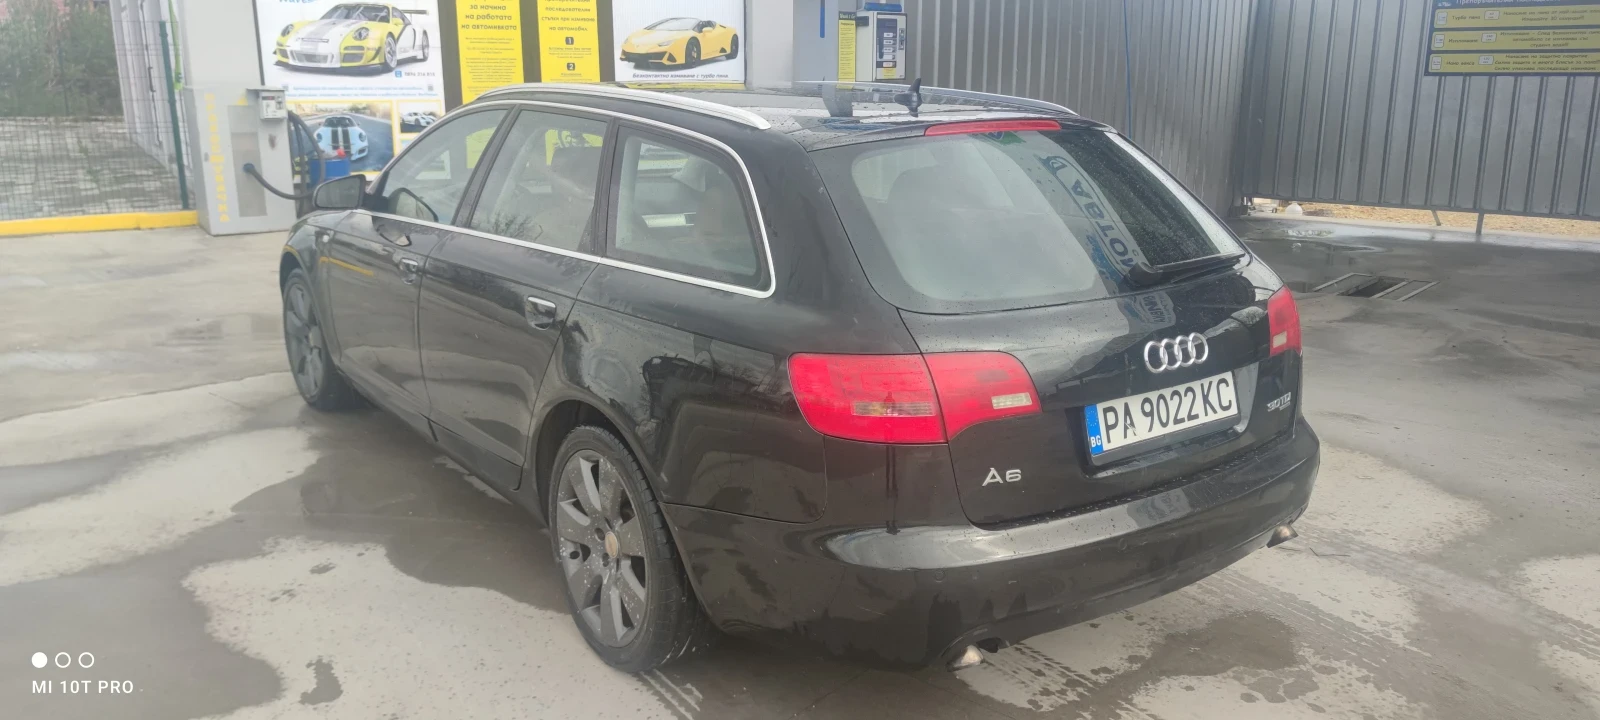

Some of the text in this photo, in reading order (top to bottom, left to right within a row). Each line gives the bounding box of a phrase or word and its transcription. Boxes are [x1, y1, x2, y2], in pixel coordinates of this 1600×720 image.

[476, 13, 512, 21] работата
[1102, 377, 1233, 444] PA 9022 KC
[1090, 435, 1102, 448] BG
[981, 467, 1022, 487] A6
